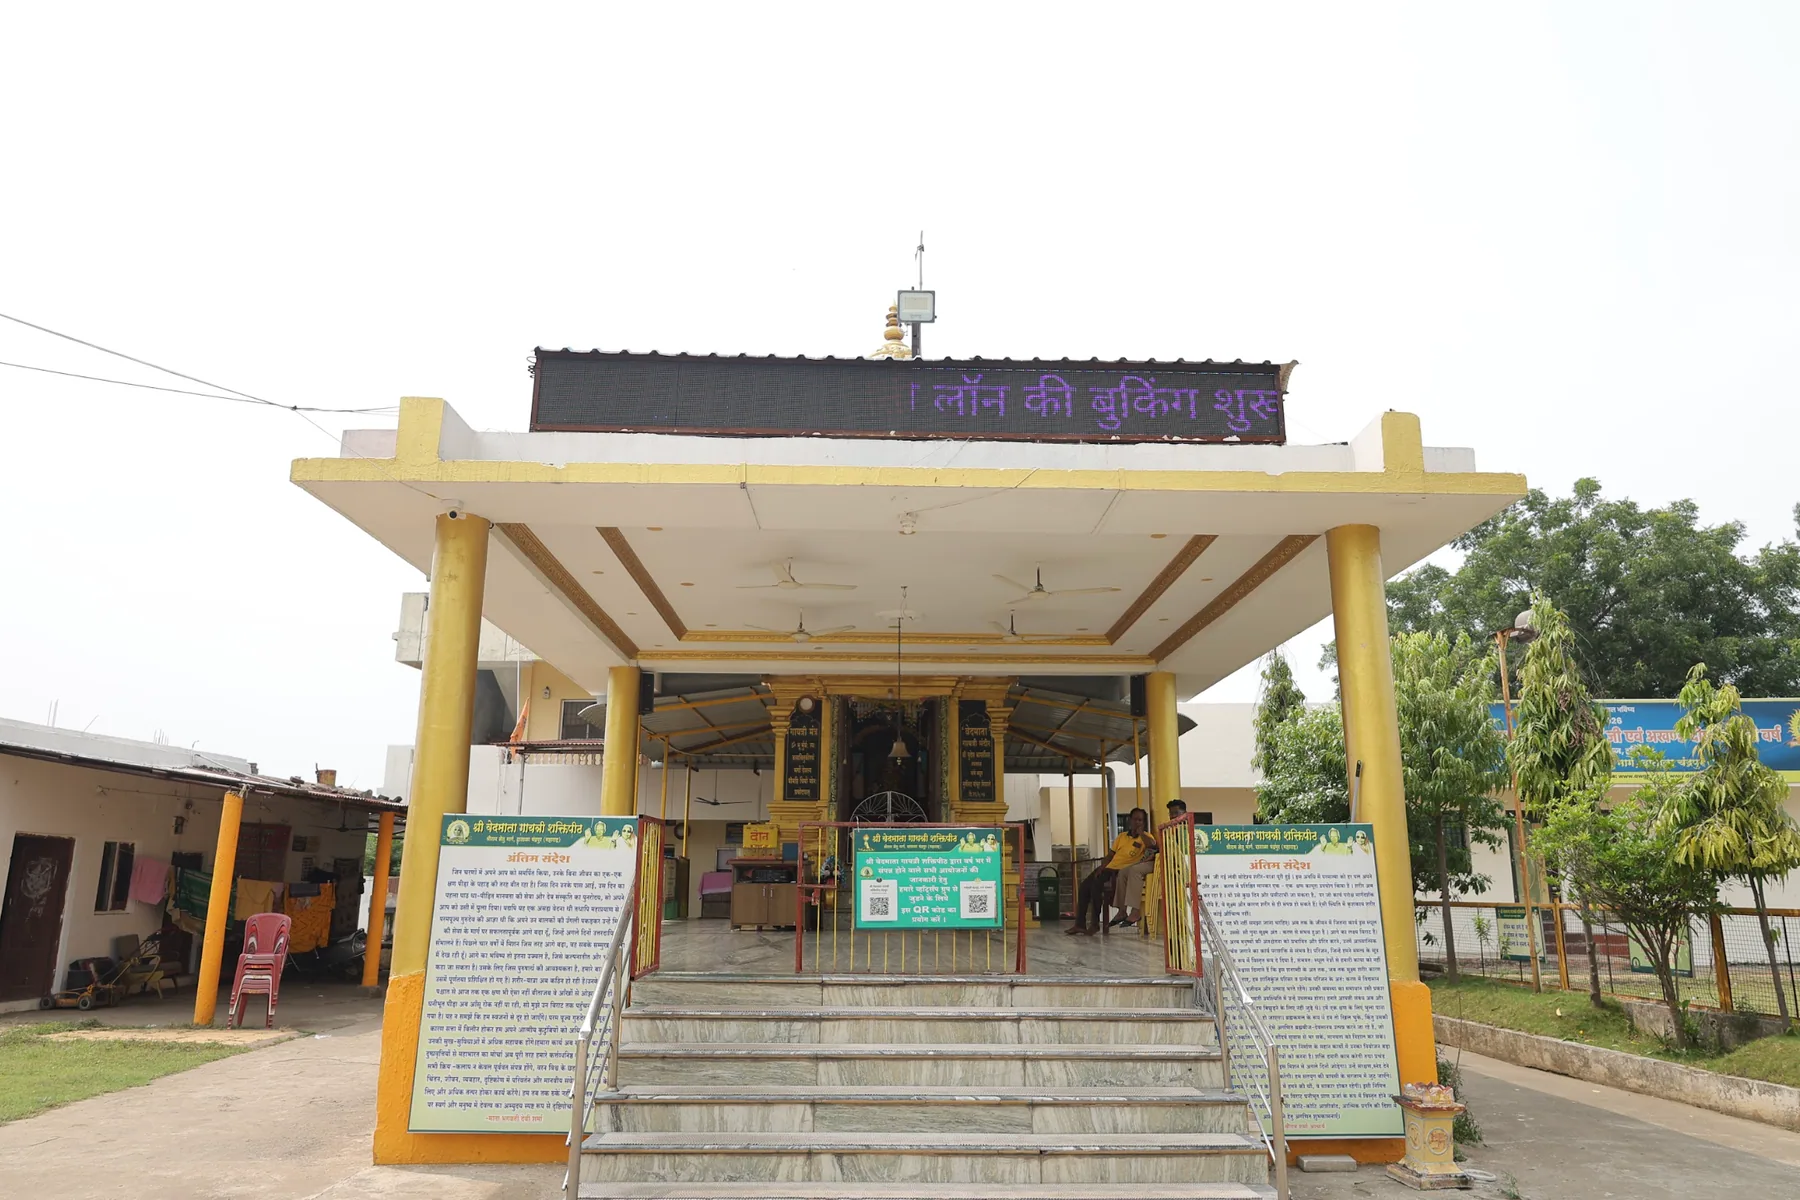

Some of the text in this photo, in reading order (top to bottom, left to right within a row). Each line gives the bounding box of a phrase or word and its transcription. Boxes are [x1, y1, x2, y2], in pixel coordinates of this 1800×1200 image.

[933, 373, 1010, 417] लॉन
[1023, 374, 1076, 418] की
[1089, 374, 1199, 430] बुकिंग
[1624, 726, 1644, 744] एवं
[1761, 724, 1782, 742] वर्ष
[473, 819, 583, 834] श्री वेदमाता गायत्री शक्तिपीठ
[1211, 828, 1318, 842] श्री वेदमाता गायत्री शक्तिपीठ
[506, 851, 571, 865] अंतिम संदेश
[1249, 859, 1311, 871] अंतिम संदेश
[913, 905, 930, 914] QR
